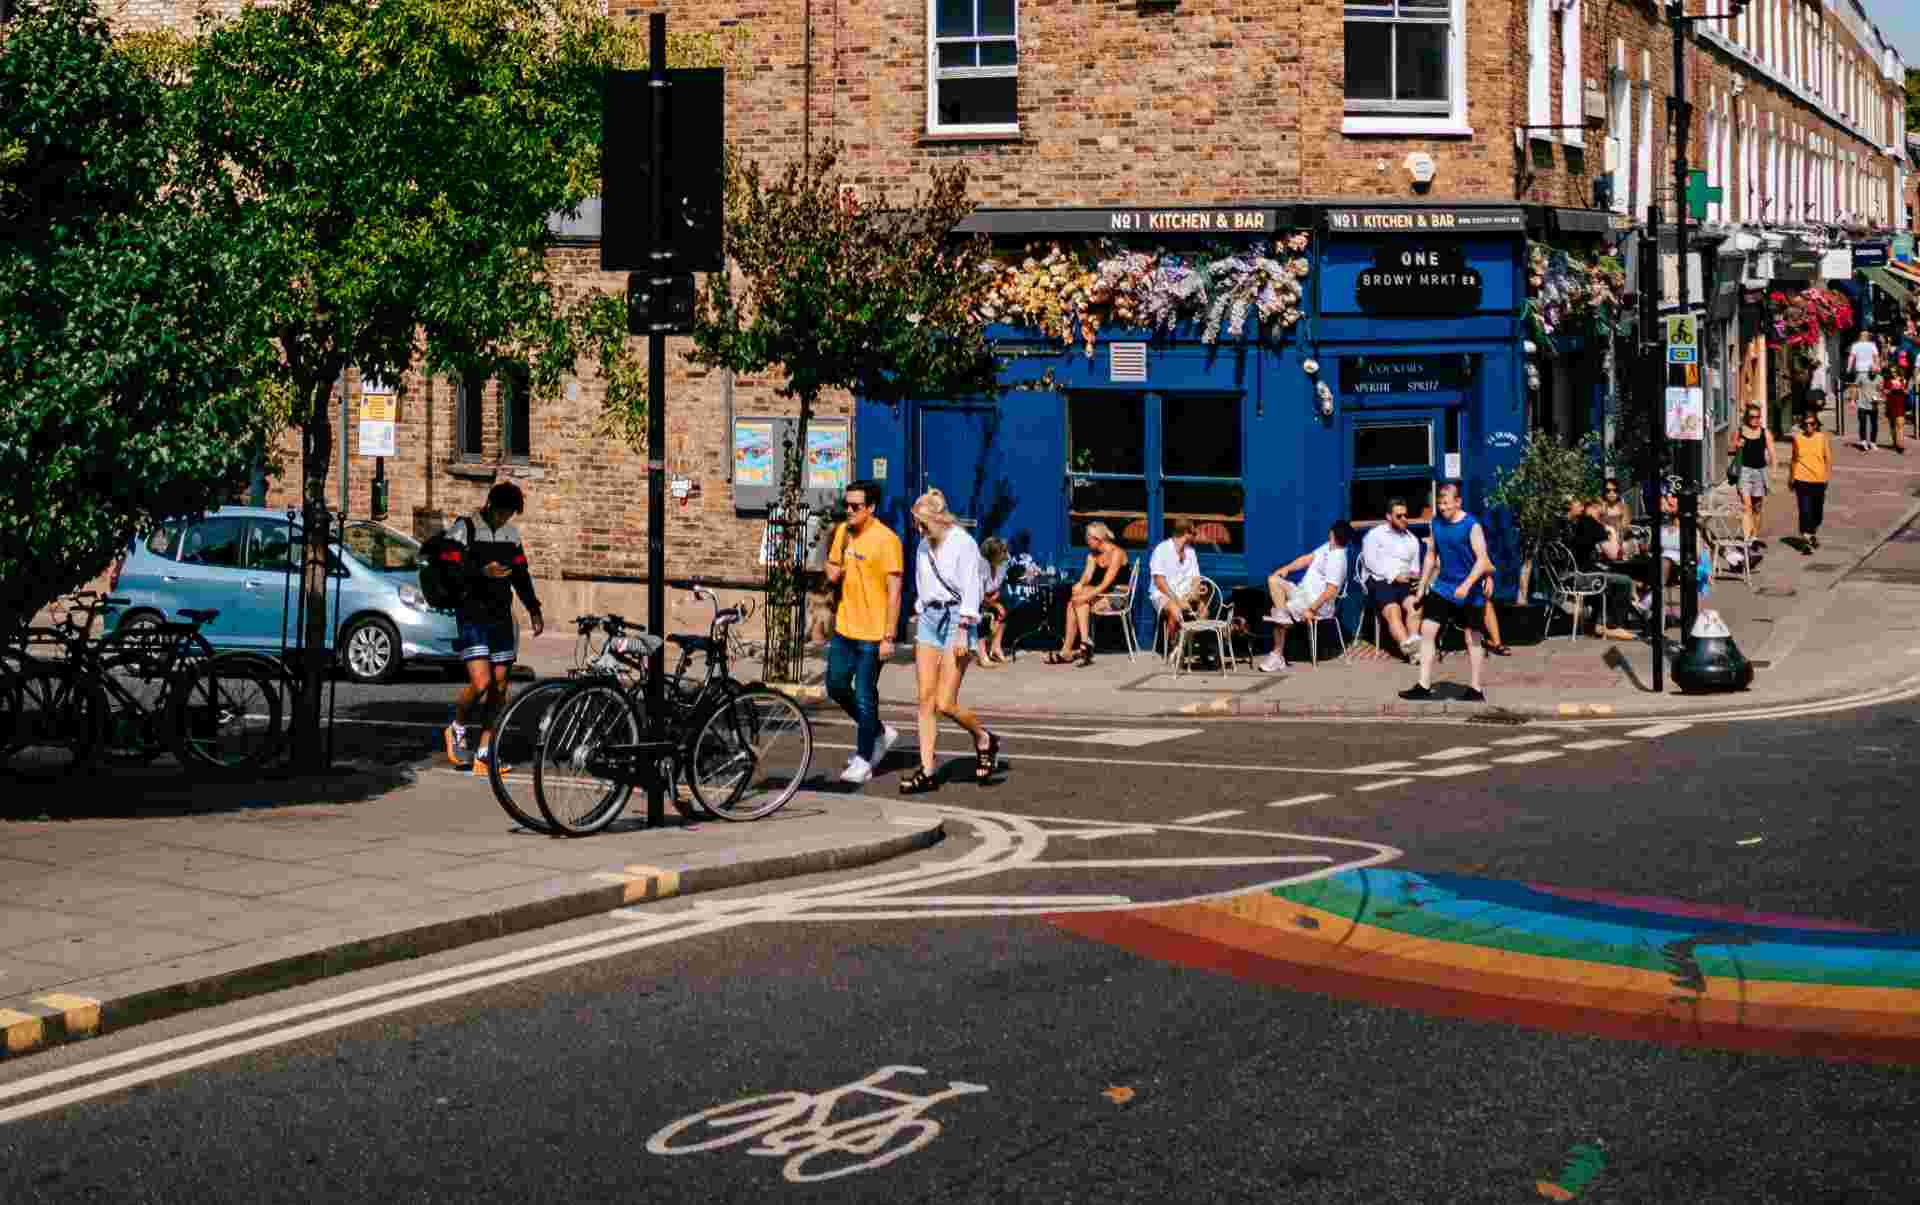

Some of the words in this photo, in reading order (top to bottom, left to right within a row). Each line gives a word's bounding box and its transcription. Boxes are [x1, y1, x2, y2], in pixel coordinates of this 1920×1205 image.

[1150, 213, 1210, 228] KITCHEN
[1216, 213, 1228, 228] &
[1233, 213, 1264, 228] BAR
[1364, 214, 1412, 228] KITCHEN
[1417, 215, 1427, 227] &
[1432, 214, 1455, 228] BAR
[1401, 251, 1440, 266] ONE
[1420, 273, 1456, 286] MRKT
